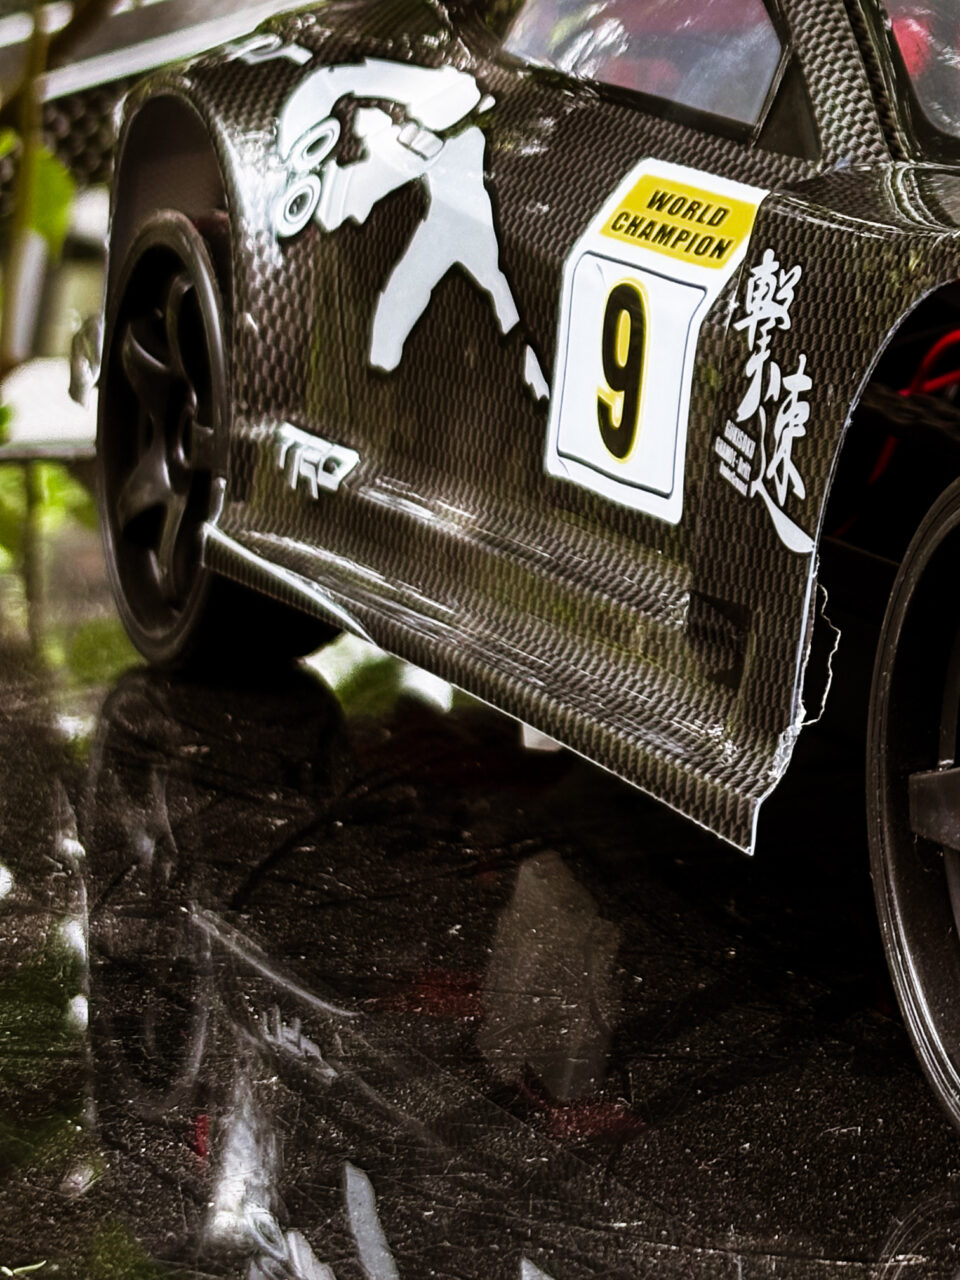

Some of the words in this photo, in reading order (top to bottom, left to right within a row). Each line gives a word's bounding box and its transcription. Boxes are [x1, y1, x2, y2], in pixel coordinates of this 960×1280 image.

[611, 213, 733, 259] CHAMPION
[647, 190, 729, 227] WORLD
[596, 280, 648, 460] 9
[277, 421, 361, 499] TRD
